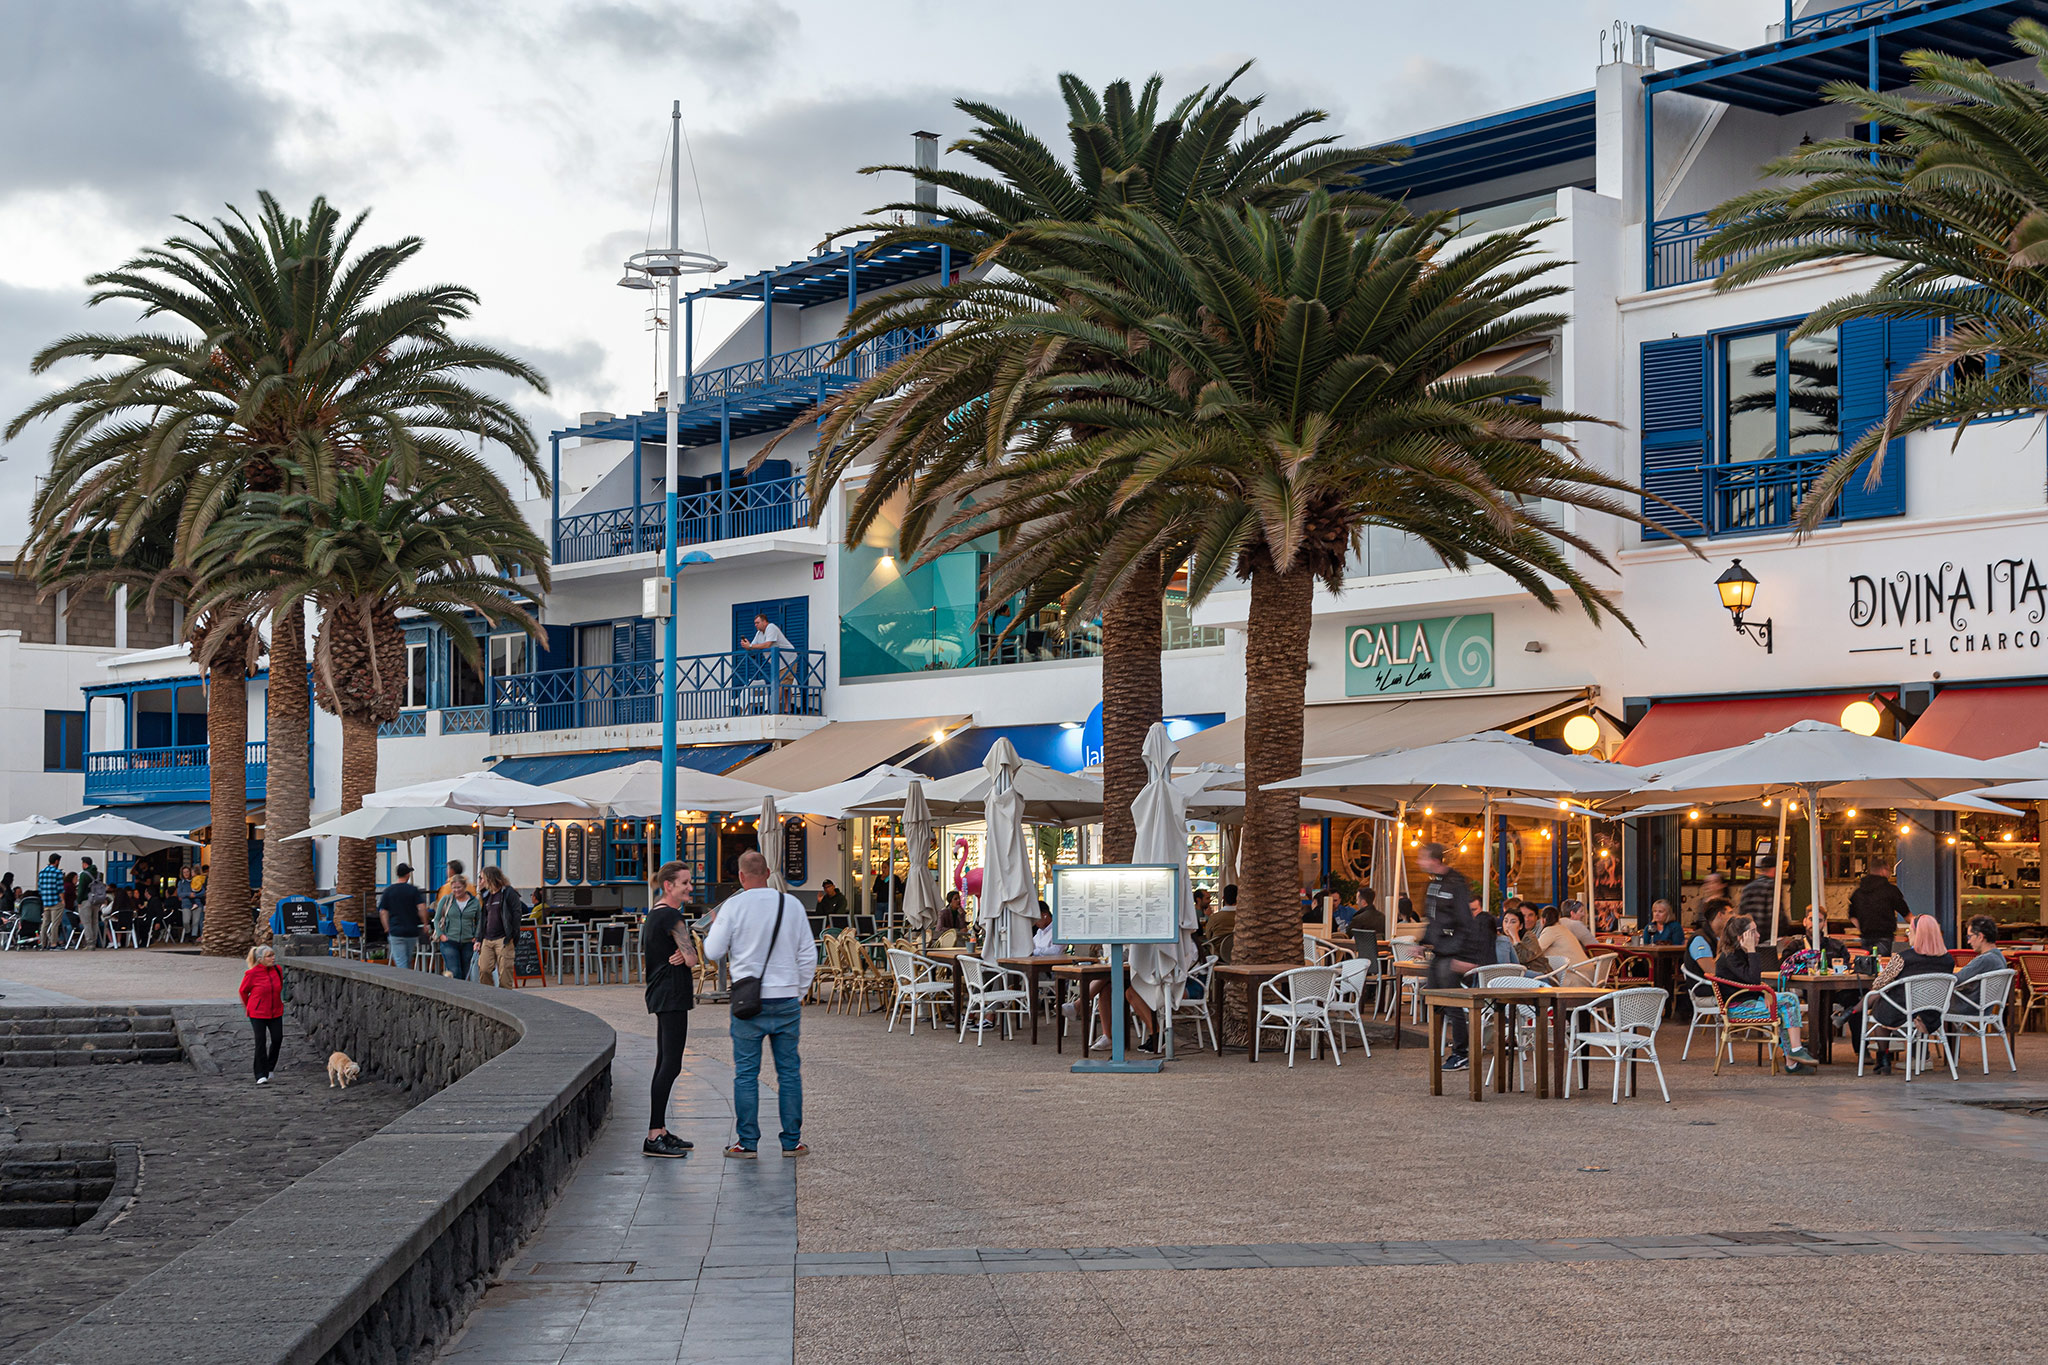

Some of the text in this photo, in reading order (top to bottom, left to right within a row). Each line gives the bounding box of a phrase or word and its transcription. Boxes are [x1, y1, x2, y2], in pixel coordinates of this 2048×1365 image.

[1849, 558, 2047, 632] DIVINA ITA
[1349, 623, 1433, 668] CALA
[1910, 630, 2040, 656] EL CHARCO
[1375, 664, 1432, 691] by Luis León
